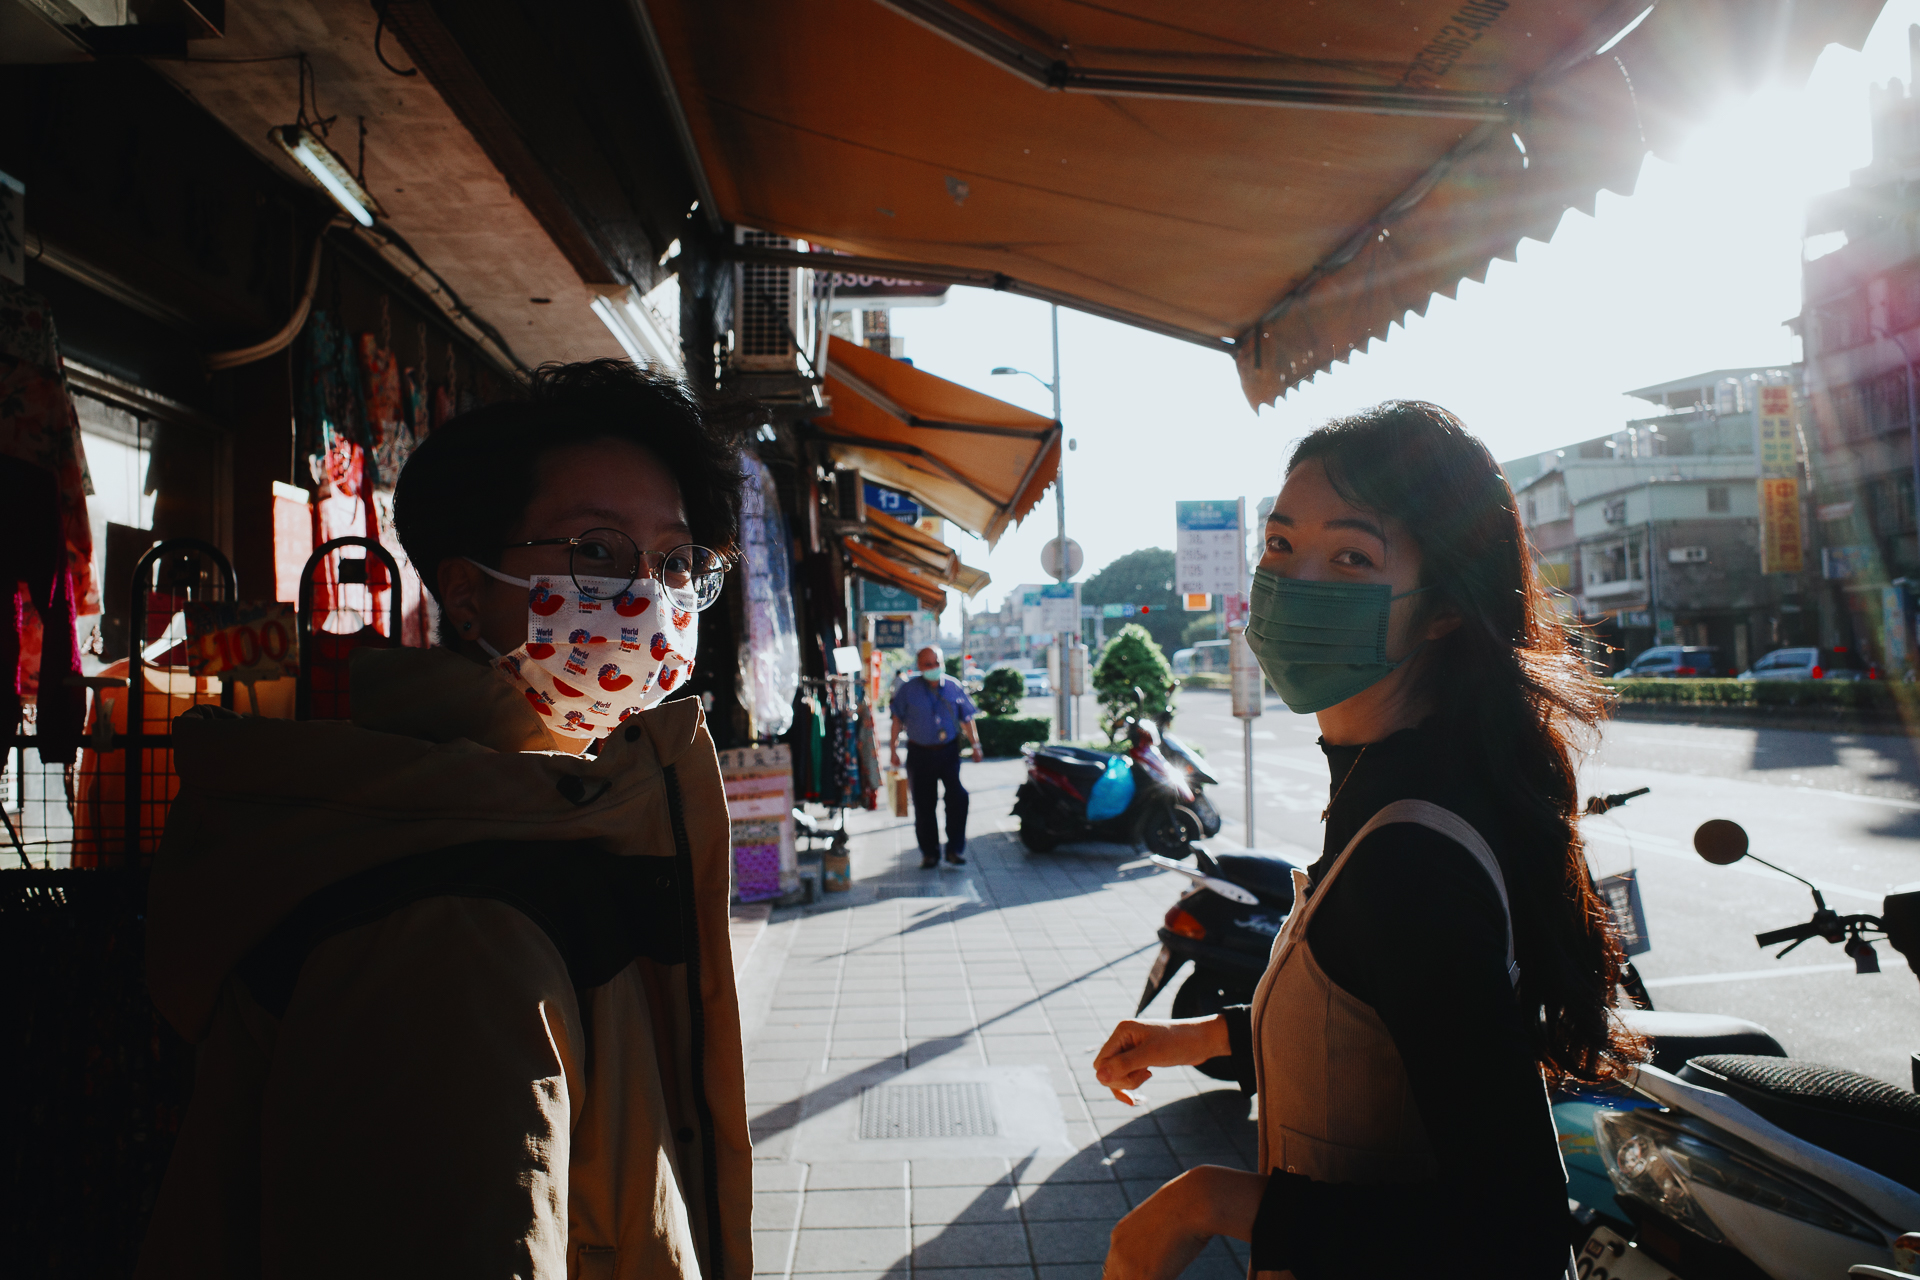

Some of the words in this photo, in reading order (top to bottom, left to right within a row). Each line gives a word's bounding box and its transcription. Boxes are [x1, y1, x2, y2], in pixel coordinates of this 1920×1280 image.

[582, 585, 599, 594] World
[578, 602, 602, 611] Festival
[536, 628, 553, 636] World
[621, 627, 639, 636] World
[621, 635, 638, 643] Music
[213, 620, 288, 671] 100
[619, 641, 641, 651] Festival
[571, 646, 590, 660] World
[567, 653, 586, 667] Music
[564, 660, 588, 676] Festival
[540, 690, 556, 706] World
[595, 700, 612, 709] World
